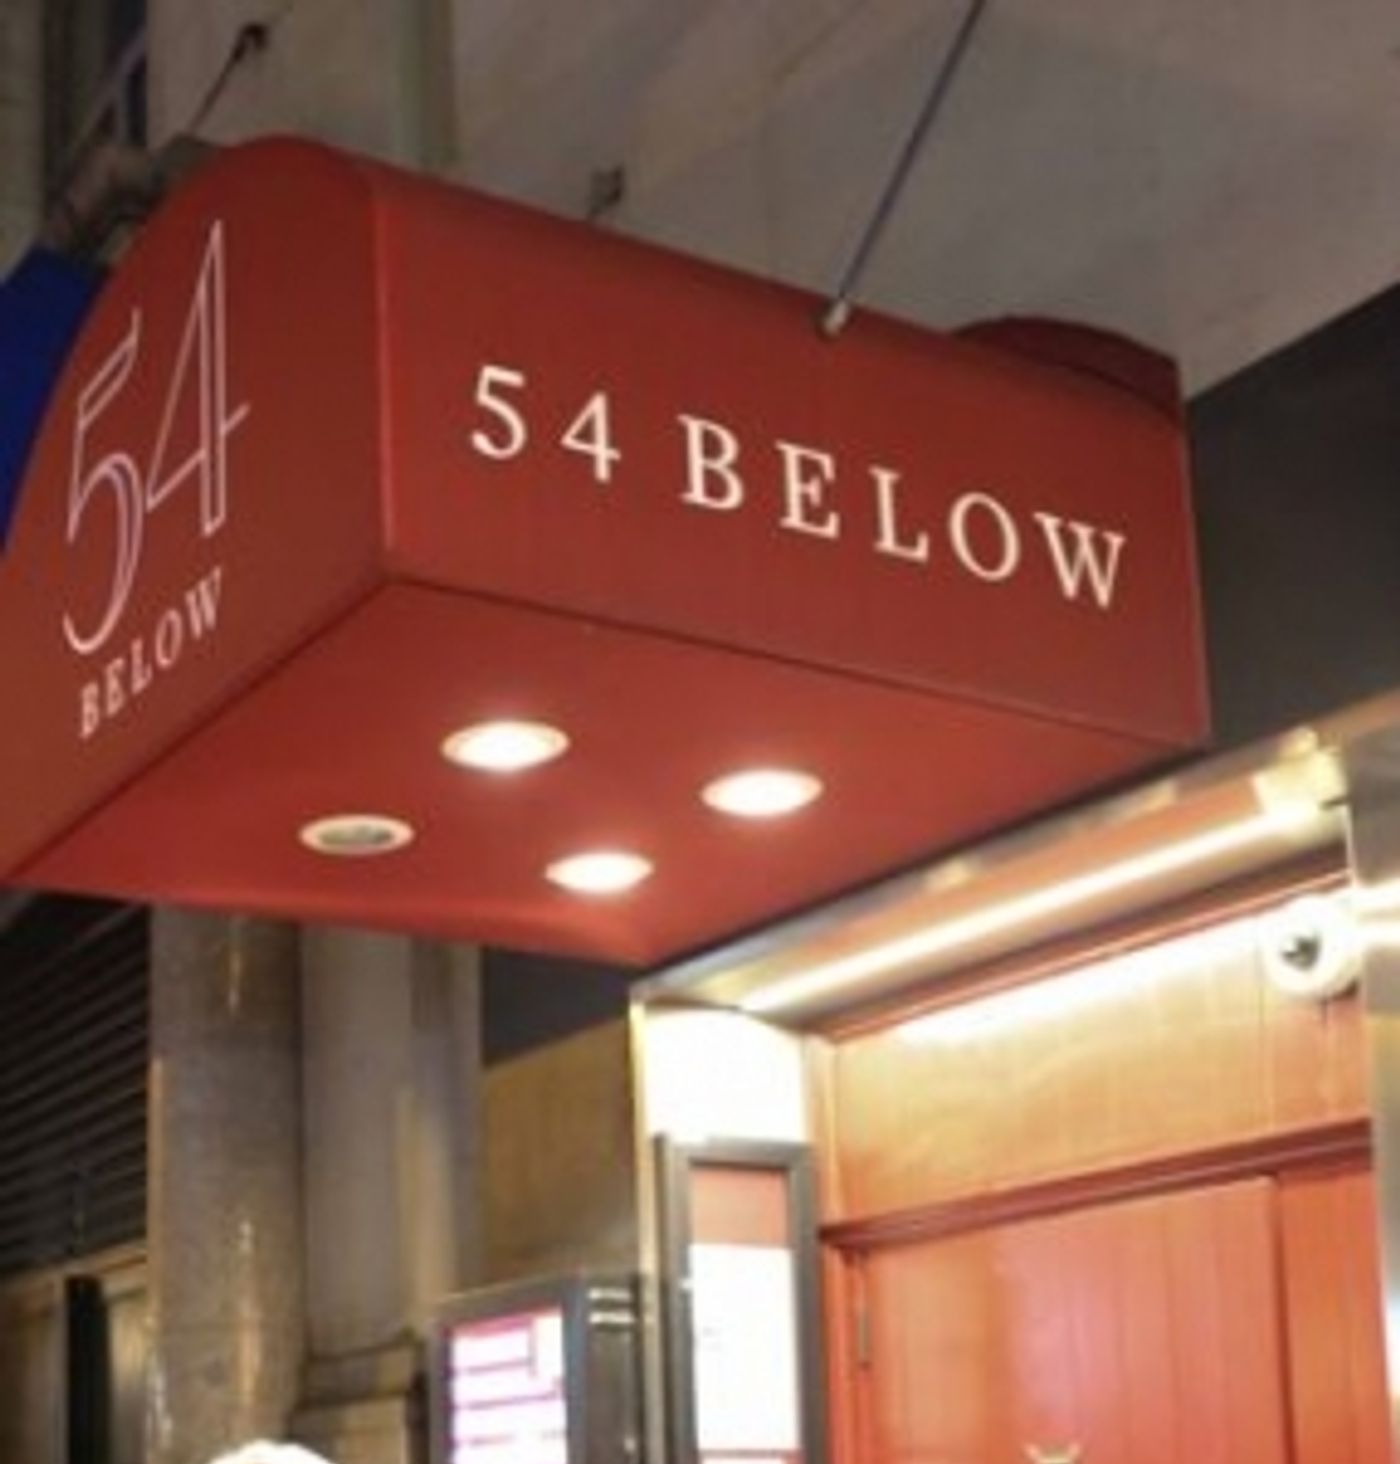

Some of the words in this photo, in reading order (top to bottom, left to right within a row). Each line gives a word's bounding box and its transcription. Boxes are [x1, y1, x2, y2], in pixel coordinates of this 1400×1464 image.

[63, 218, 250, 655] 54
[469, 363, 622, 484] 54
[676, 412, 1127, 609] BELOW
[79, 566, 223, 740] BELOW
